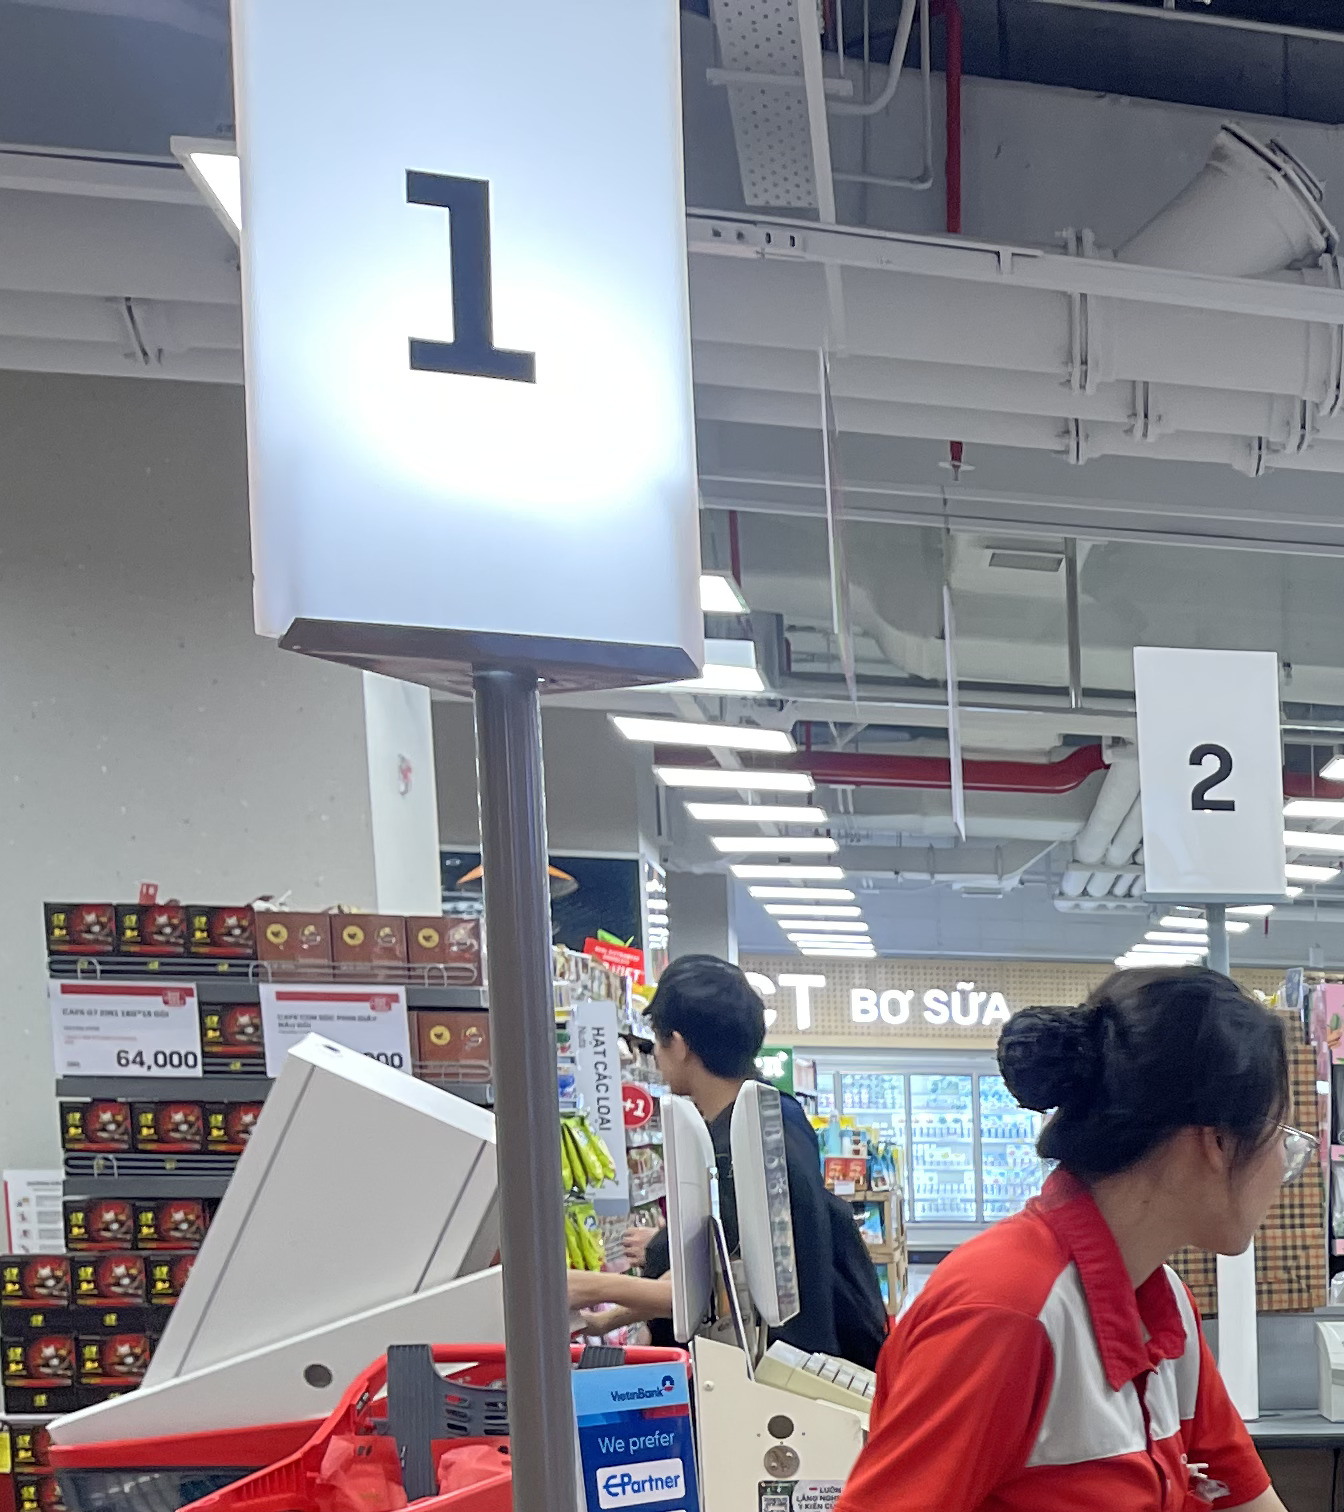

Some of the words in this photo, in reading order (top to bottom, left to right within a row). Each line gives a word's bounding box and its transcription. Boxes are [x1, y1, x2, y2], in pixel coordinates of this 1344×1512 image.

[406, 168, 537, 384] 1
[1189, 743, 1236, 812] 2
[851, 988, 914, 1025] BƠ
[923, 981, 1011, 1026] SỮA
[116, 1049, 198, 1071] 64,000
[598, 1434, 626, 1455] We
[628, 1430, 676, 1456] prefer
